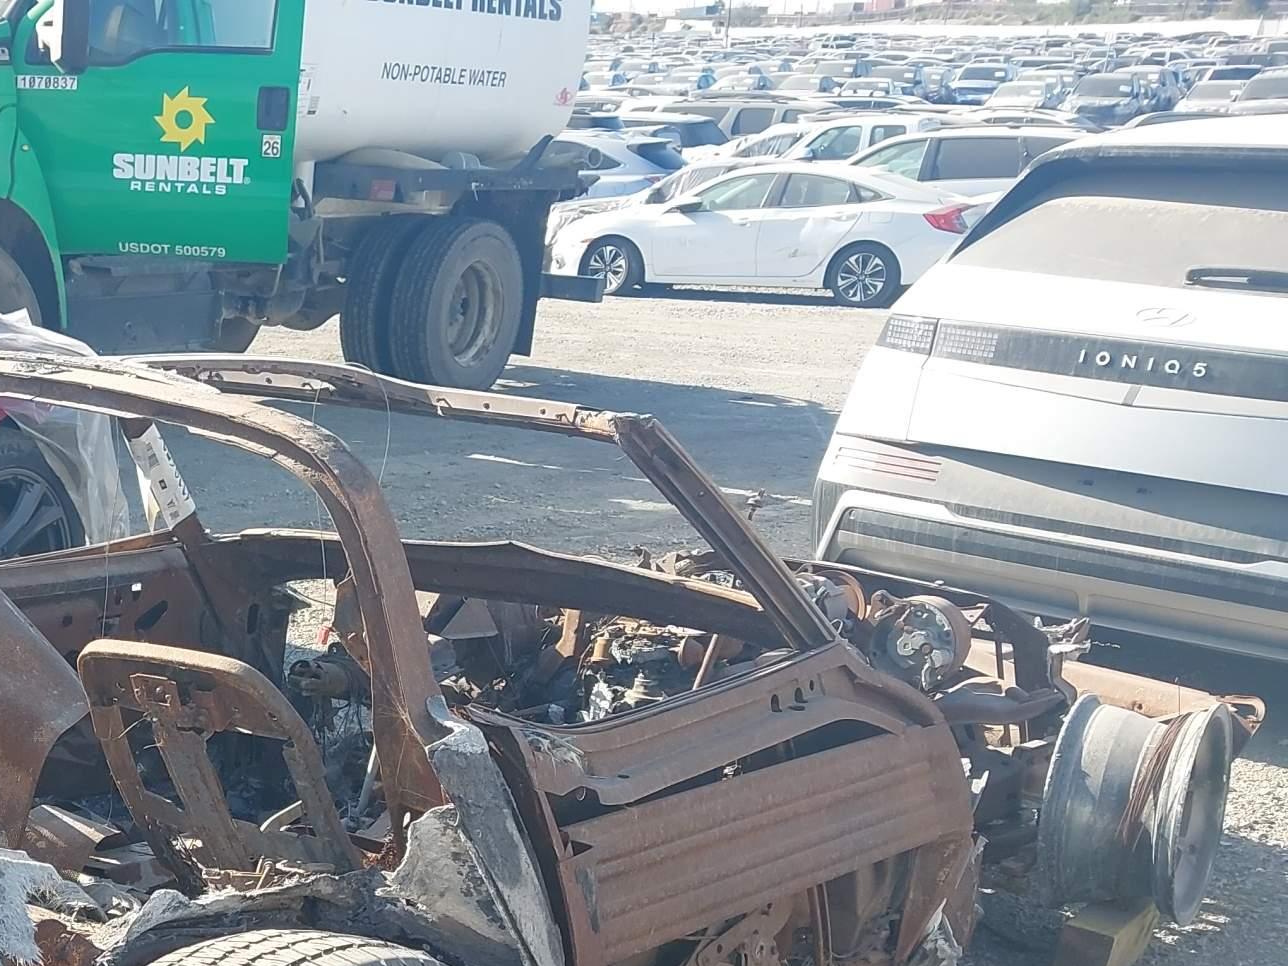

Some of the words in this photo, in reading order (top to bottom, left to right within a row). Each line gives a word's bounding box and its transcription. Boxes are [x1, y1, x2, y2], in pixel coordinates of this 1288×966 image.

[20, 76, 77, 89] 1070837
[381, 62, 466, 85] NON-POTABLE
[468, 69, 507, 87] WATER
[263, 140, 280, 156] 26
[112, 153, 249, 184] SUNBELT
[130, 181, 227, 195] RENTALS
[118, 242, 171, 254] USDOT
[175, 245, 226, 257] 500579
[1078, 349, 1181, 374] IONIQ
[1192, 362, 1208, 377] 5
